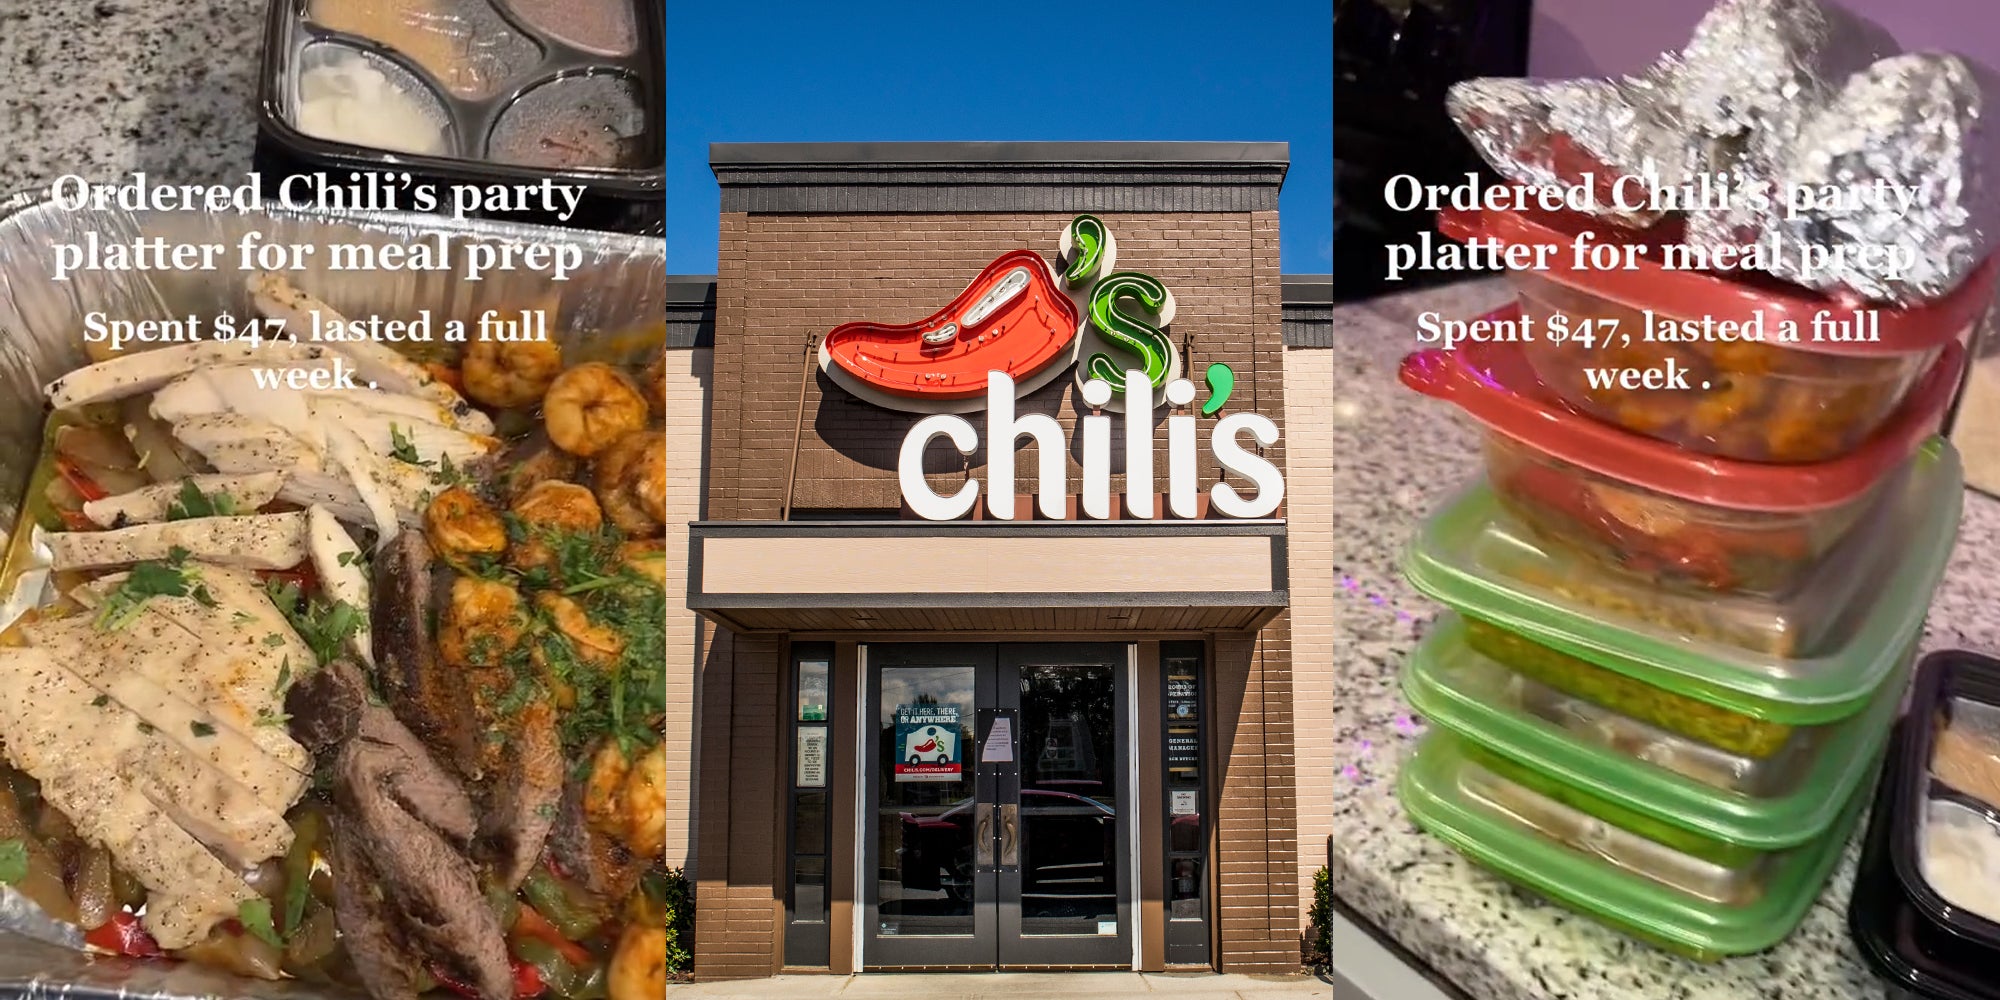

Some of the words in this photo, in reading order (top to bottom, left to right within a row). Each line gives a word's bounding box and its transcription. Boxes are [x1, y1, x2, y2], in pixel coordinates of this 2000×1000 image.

[898, 363, 1285, 520] chili's
[937, 706, 958, 716] THERE,
[900, 715, 910, 724] OR
